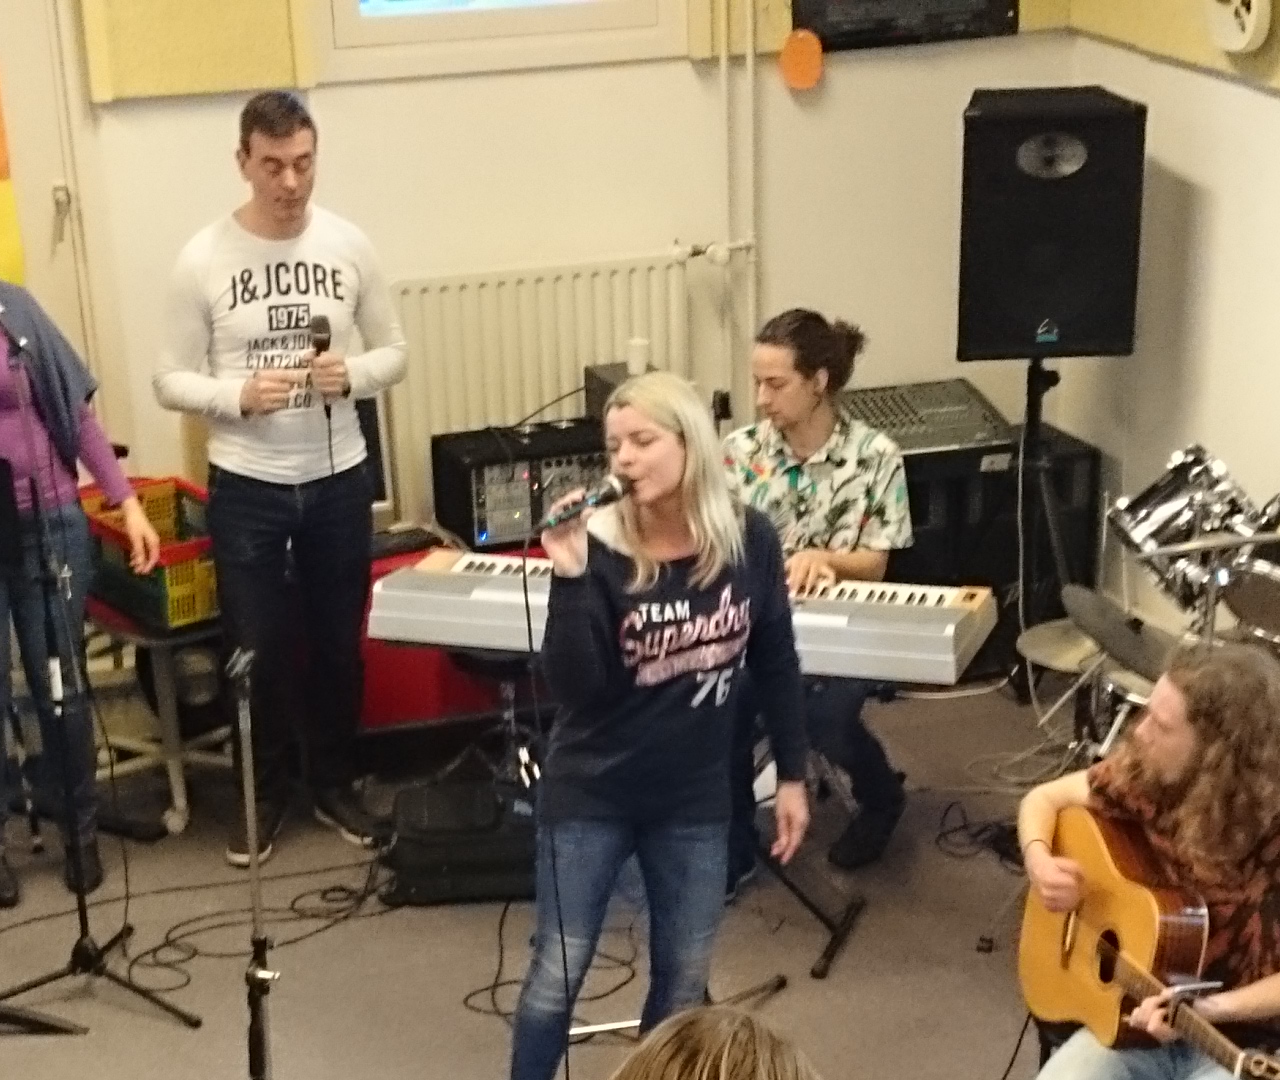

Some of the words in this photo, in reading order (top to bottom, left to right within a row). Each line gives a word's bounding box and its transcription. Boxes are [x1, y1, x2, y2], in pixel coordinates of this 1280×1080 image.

[269, 304, 310, 330] 1975
[620, 583, 751, 668] Superdry
[638, 599, 690, 623] TEAM
[691, 668, 734, 708] 76
